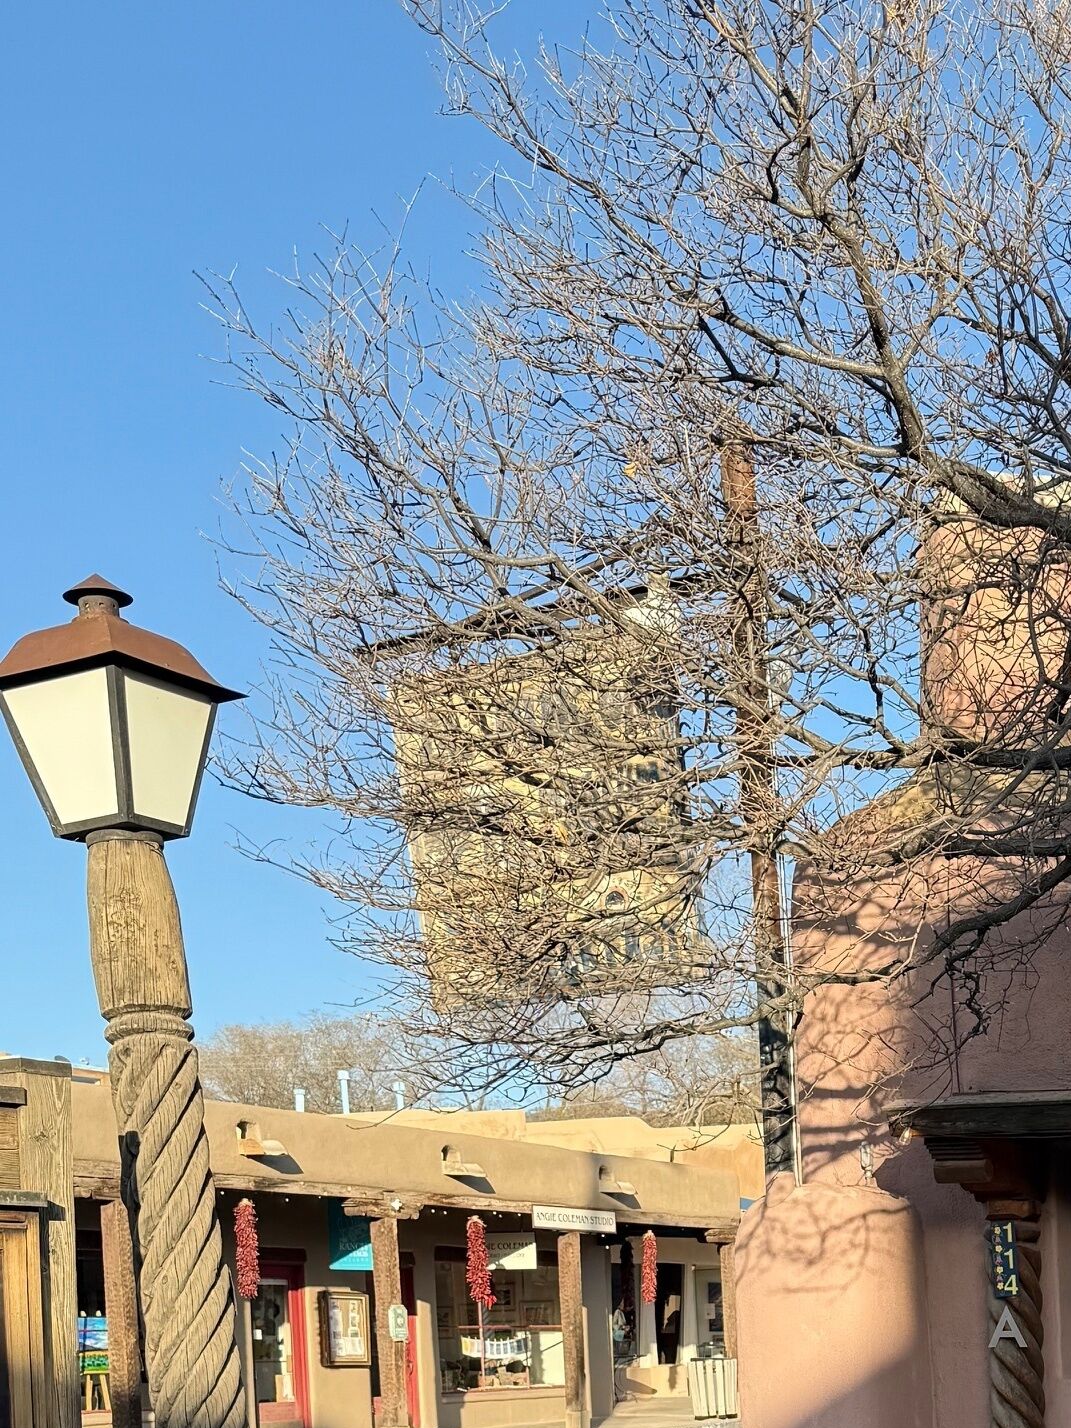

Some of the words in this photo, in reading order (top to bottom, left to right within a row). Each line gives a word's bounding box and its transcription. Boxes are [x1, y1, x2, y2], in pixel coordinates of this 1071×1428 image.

[536, 1212, 557, 1222] ANGIE
[558, 1213, 589, 1224] COLEMAN
[590, 1215, 614, 1226] STUDIO
[1003, 1222, 1019, 1295] 114
[988, 1304, 1028, 1348] A
